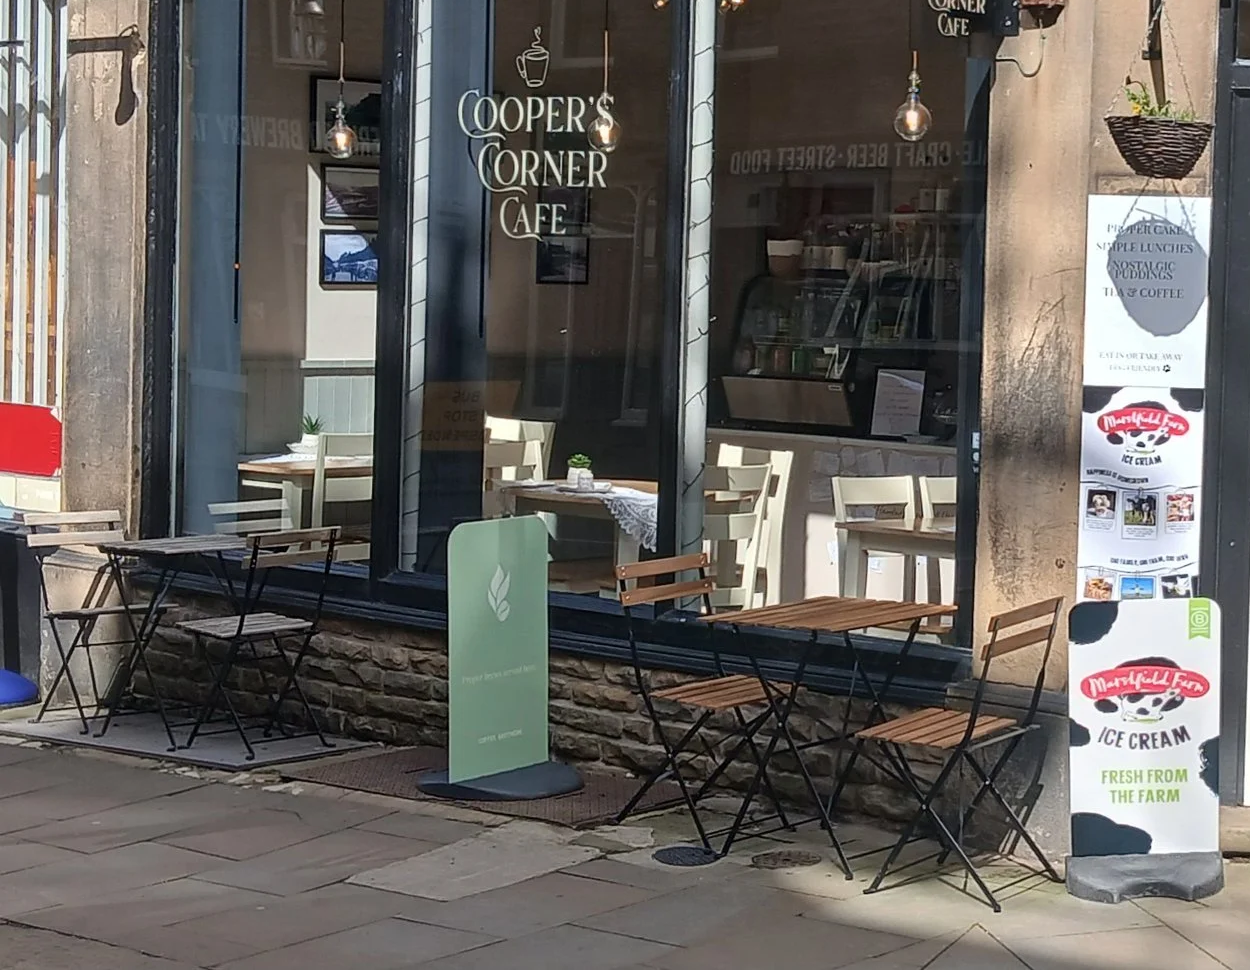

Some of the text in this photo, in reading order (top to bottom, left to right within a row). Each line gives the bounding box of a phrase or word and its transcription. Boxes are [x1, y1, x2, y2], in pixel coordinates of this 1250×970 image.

[938, 13, 969, 37] CAFE
[458, 89, 614, 140] COOPER'S
[478, 142, 608, 195] CORNER
[500, 197, 567, 241] CAFE
[1096, 242, 1194, 254] SIMPLE LUNCHES
[1112, 260, 1176, 271] NOSTALGIC
[1115, 269, 1173, 280] PUDDINGS
[1102, 287, 1184, 298] TEA & COFFEE
[1121, 454, 1162, 466] ICE CREAM
[1091, 671, 1204, 696] Marshfield Farm
[1098, 725, 1192, 750] ICE CREAM
[1101, 768, 1189, 784] FRESH FROM
[1109, 789, 1180, 804] THE FARM
